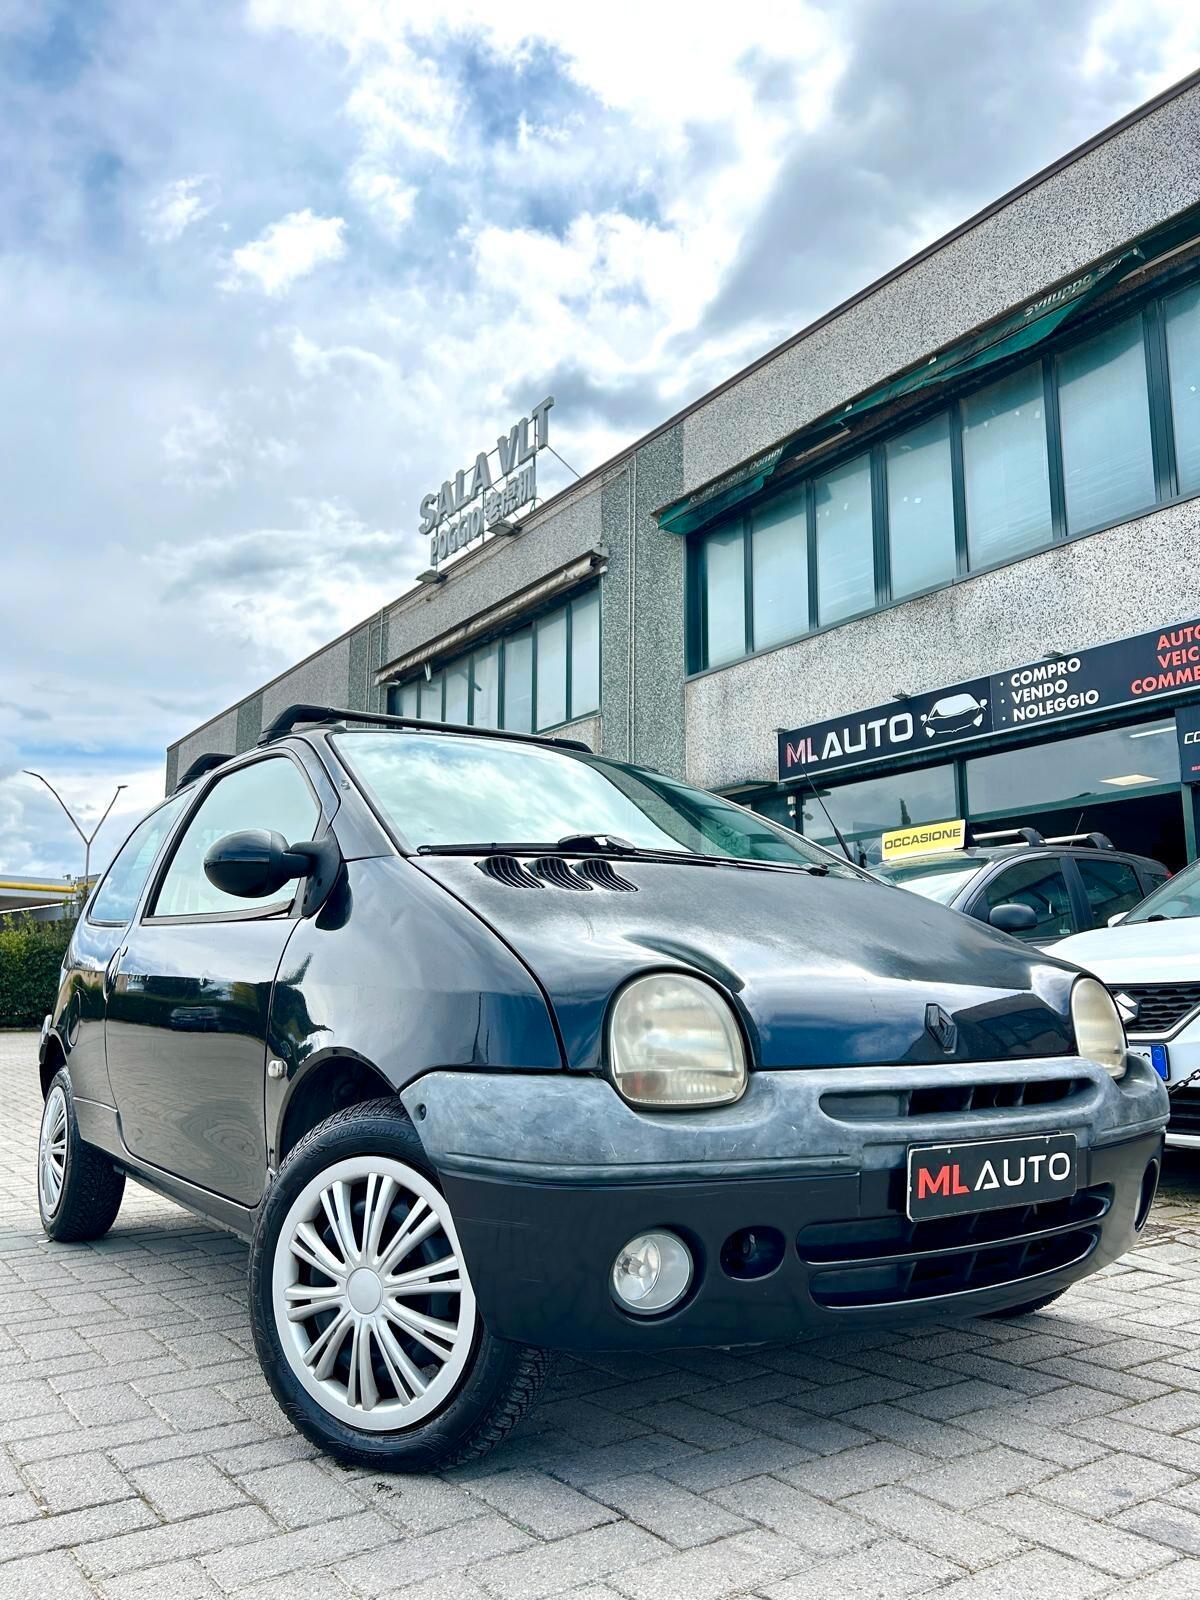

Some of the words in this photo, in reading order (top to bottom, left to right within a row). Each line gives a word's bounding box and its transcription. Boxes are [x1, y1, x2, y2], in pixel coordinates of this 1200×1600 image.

[418, 451, 492, 535] SALA
[497, 395, 554, 477] VLT
[430, 506, 485, 566] POGGIO
[1010, 657, 1081, 687] COMPRO
[1011, 679, 1068, 704] VENDO
[1013, 689, 1099, 722] NOLEGGIO
[884, 827, 961, 850] OCCASIONE
